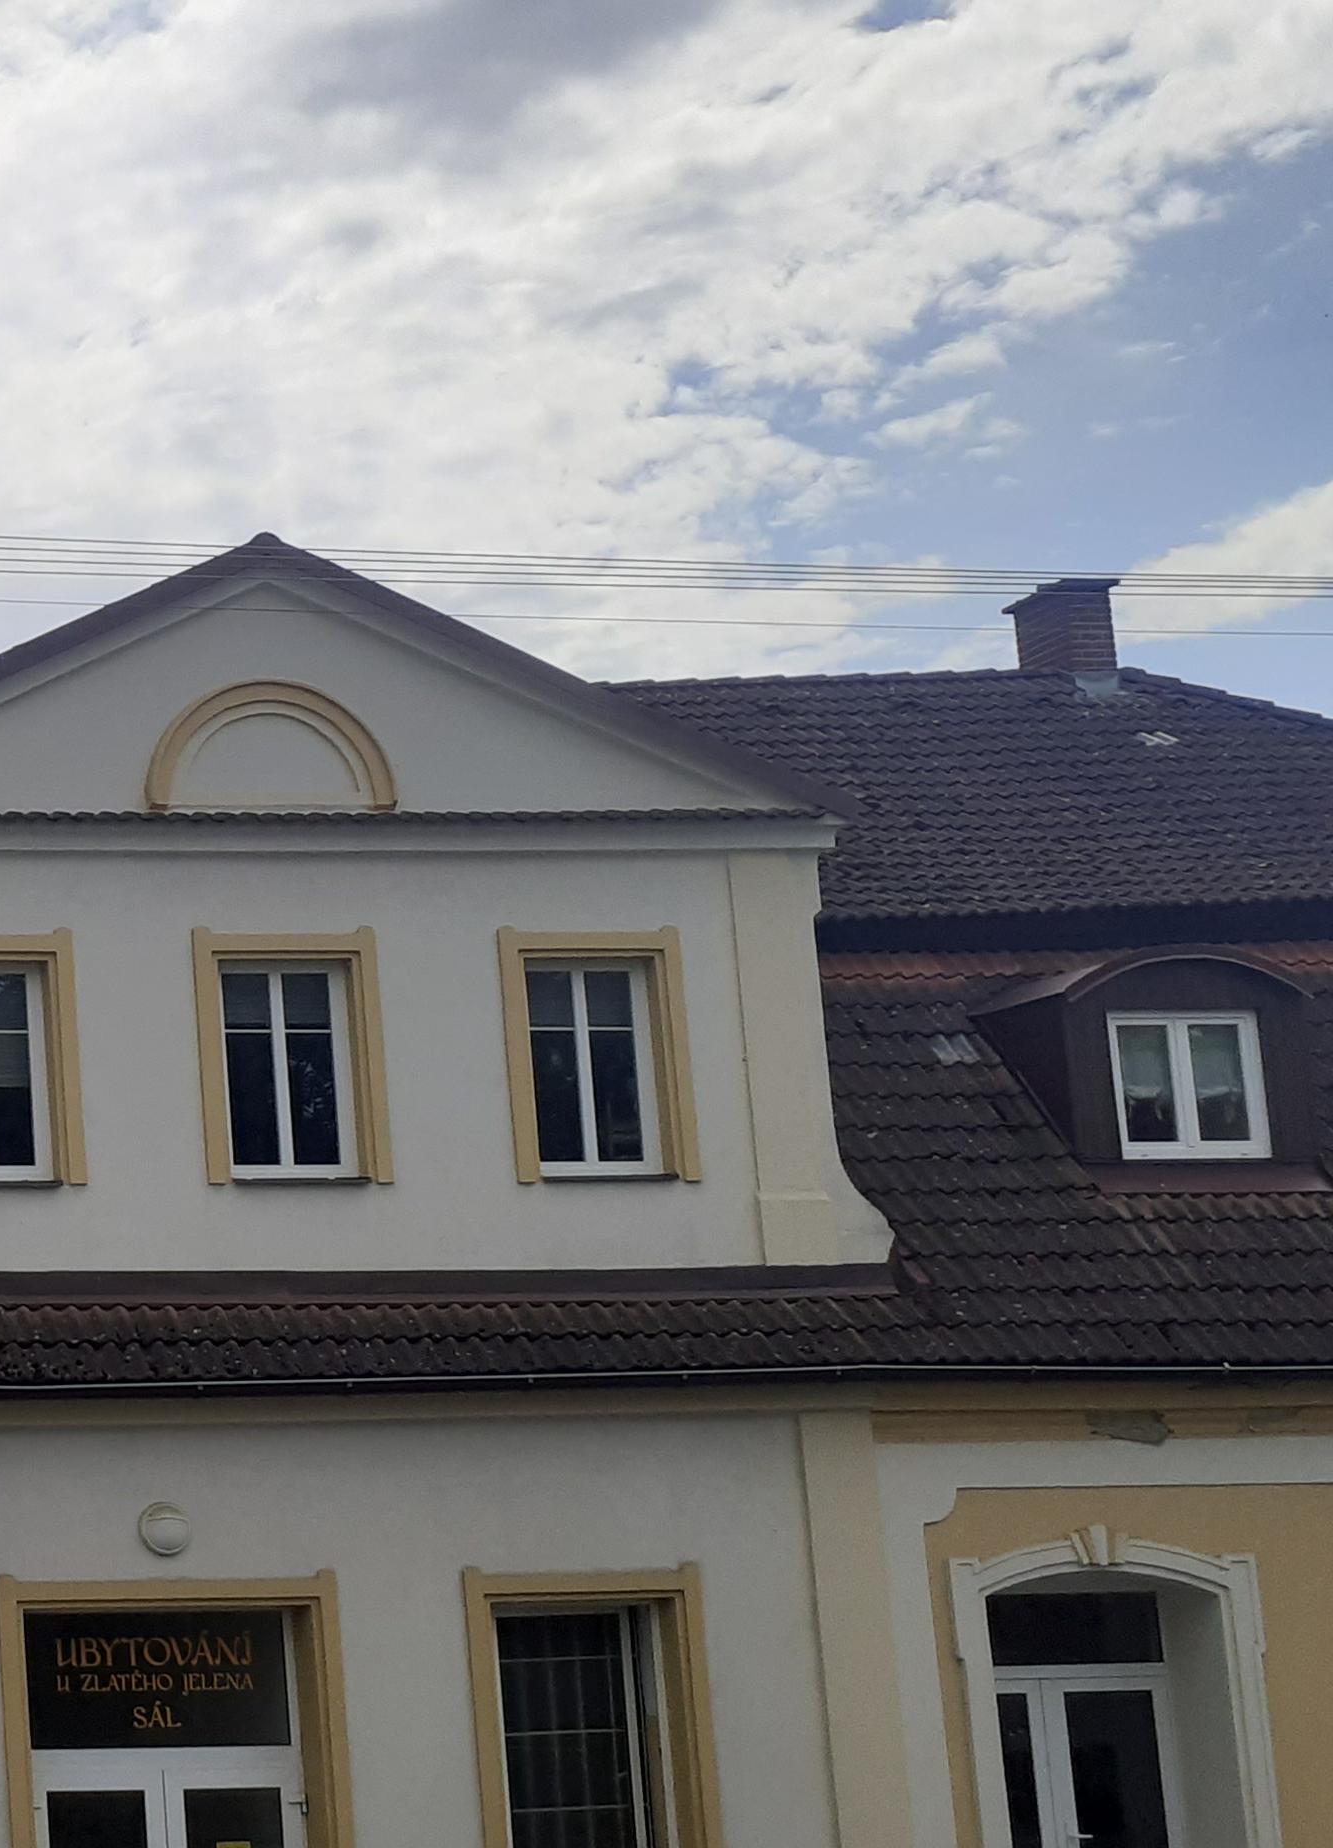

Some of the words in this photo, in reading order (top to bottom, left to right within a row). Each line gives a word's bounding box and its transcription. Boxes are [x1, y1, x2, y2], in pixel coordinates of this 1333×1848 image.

[55, 1631, 253, 1667] UBYTOVÁNÍ
[56, 1675, 70, 1692] U
[80, 1669, 174, 1692] ZLATÉHO
[183, 1673, 253, 1695] JELENA
[132, 1700, 183, 1730] SÁL
